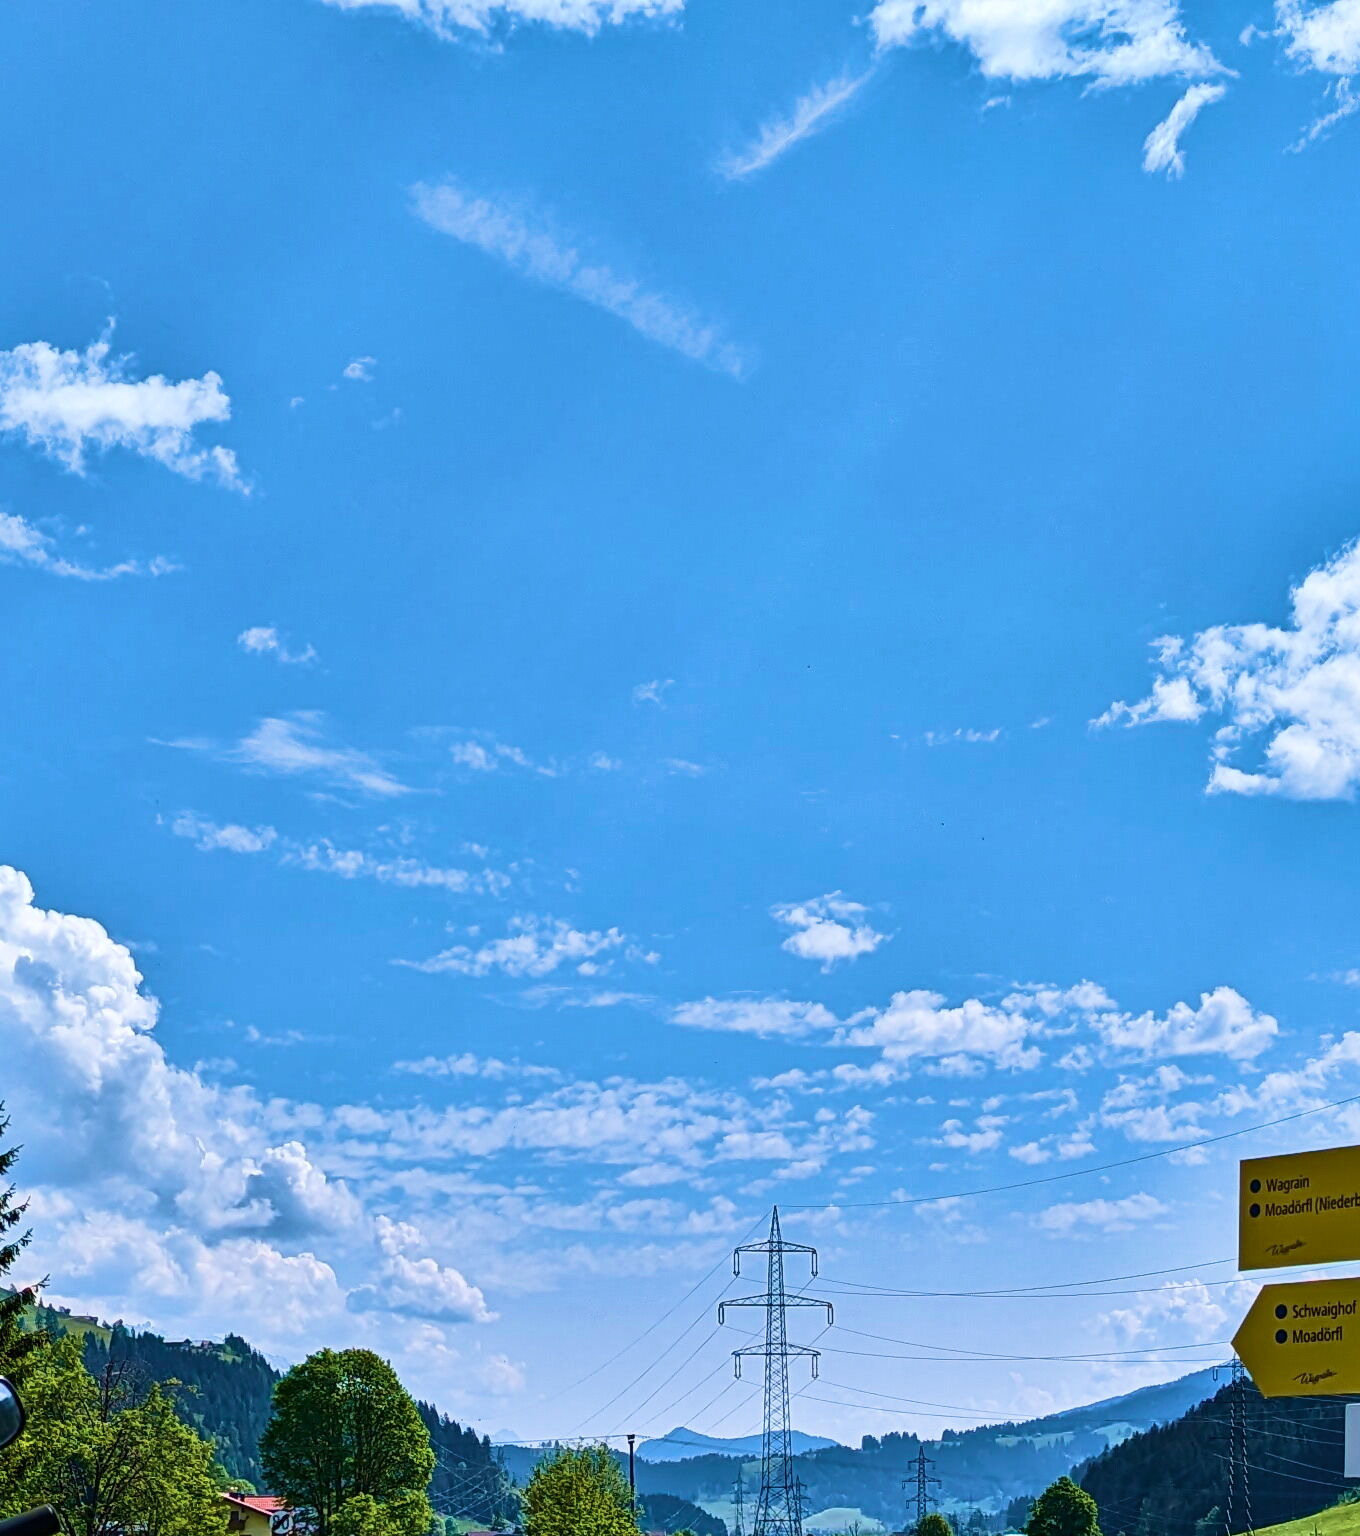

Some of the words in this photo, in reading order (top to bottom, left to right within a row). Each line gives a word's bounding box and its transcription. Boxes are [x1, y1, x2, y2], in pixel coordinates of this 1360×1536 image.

[1266, 1175, 1310, 1194] Wagrain
[1265, 1197, 1313, 1217] Moadörfl
[1292, 1300, 1357, 1320] Schwaighof
[1292, 1326, 1343, 1344] Moadörfl
